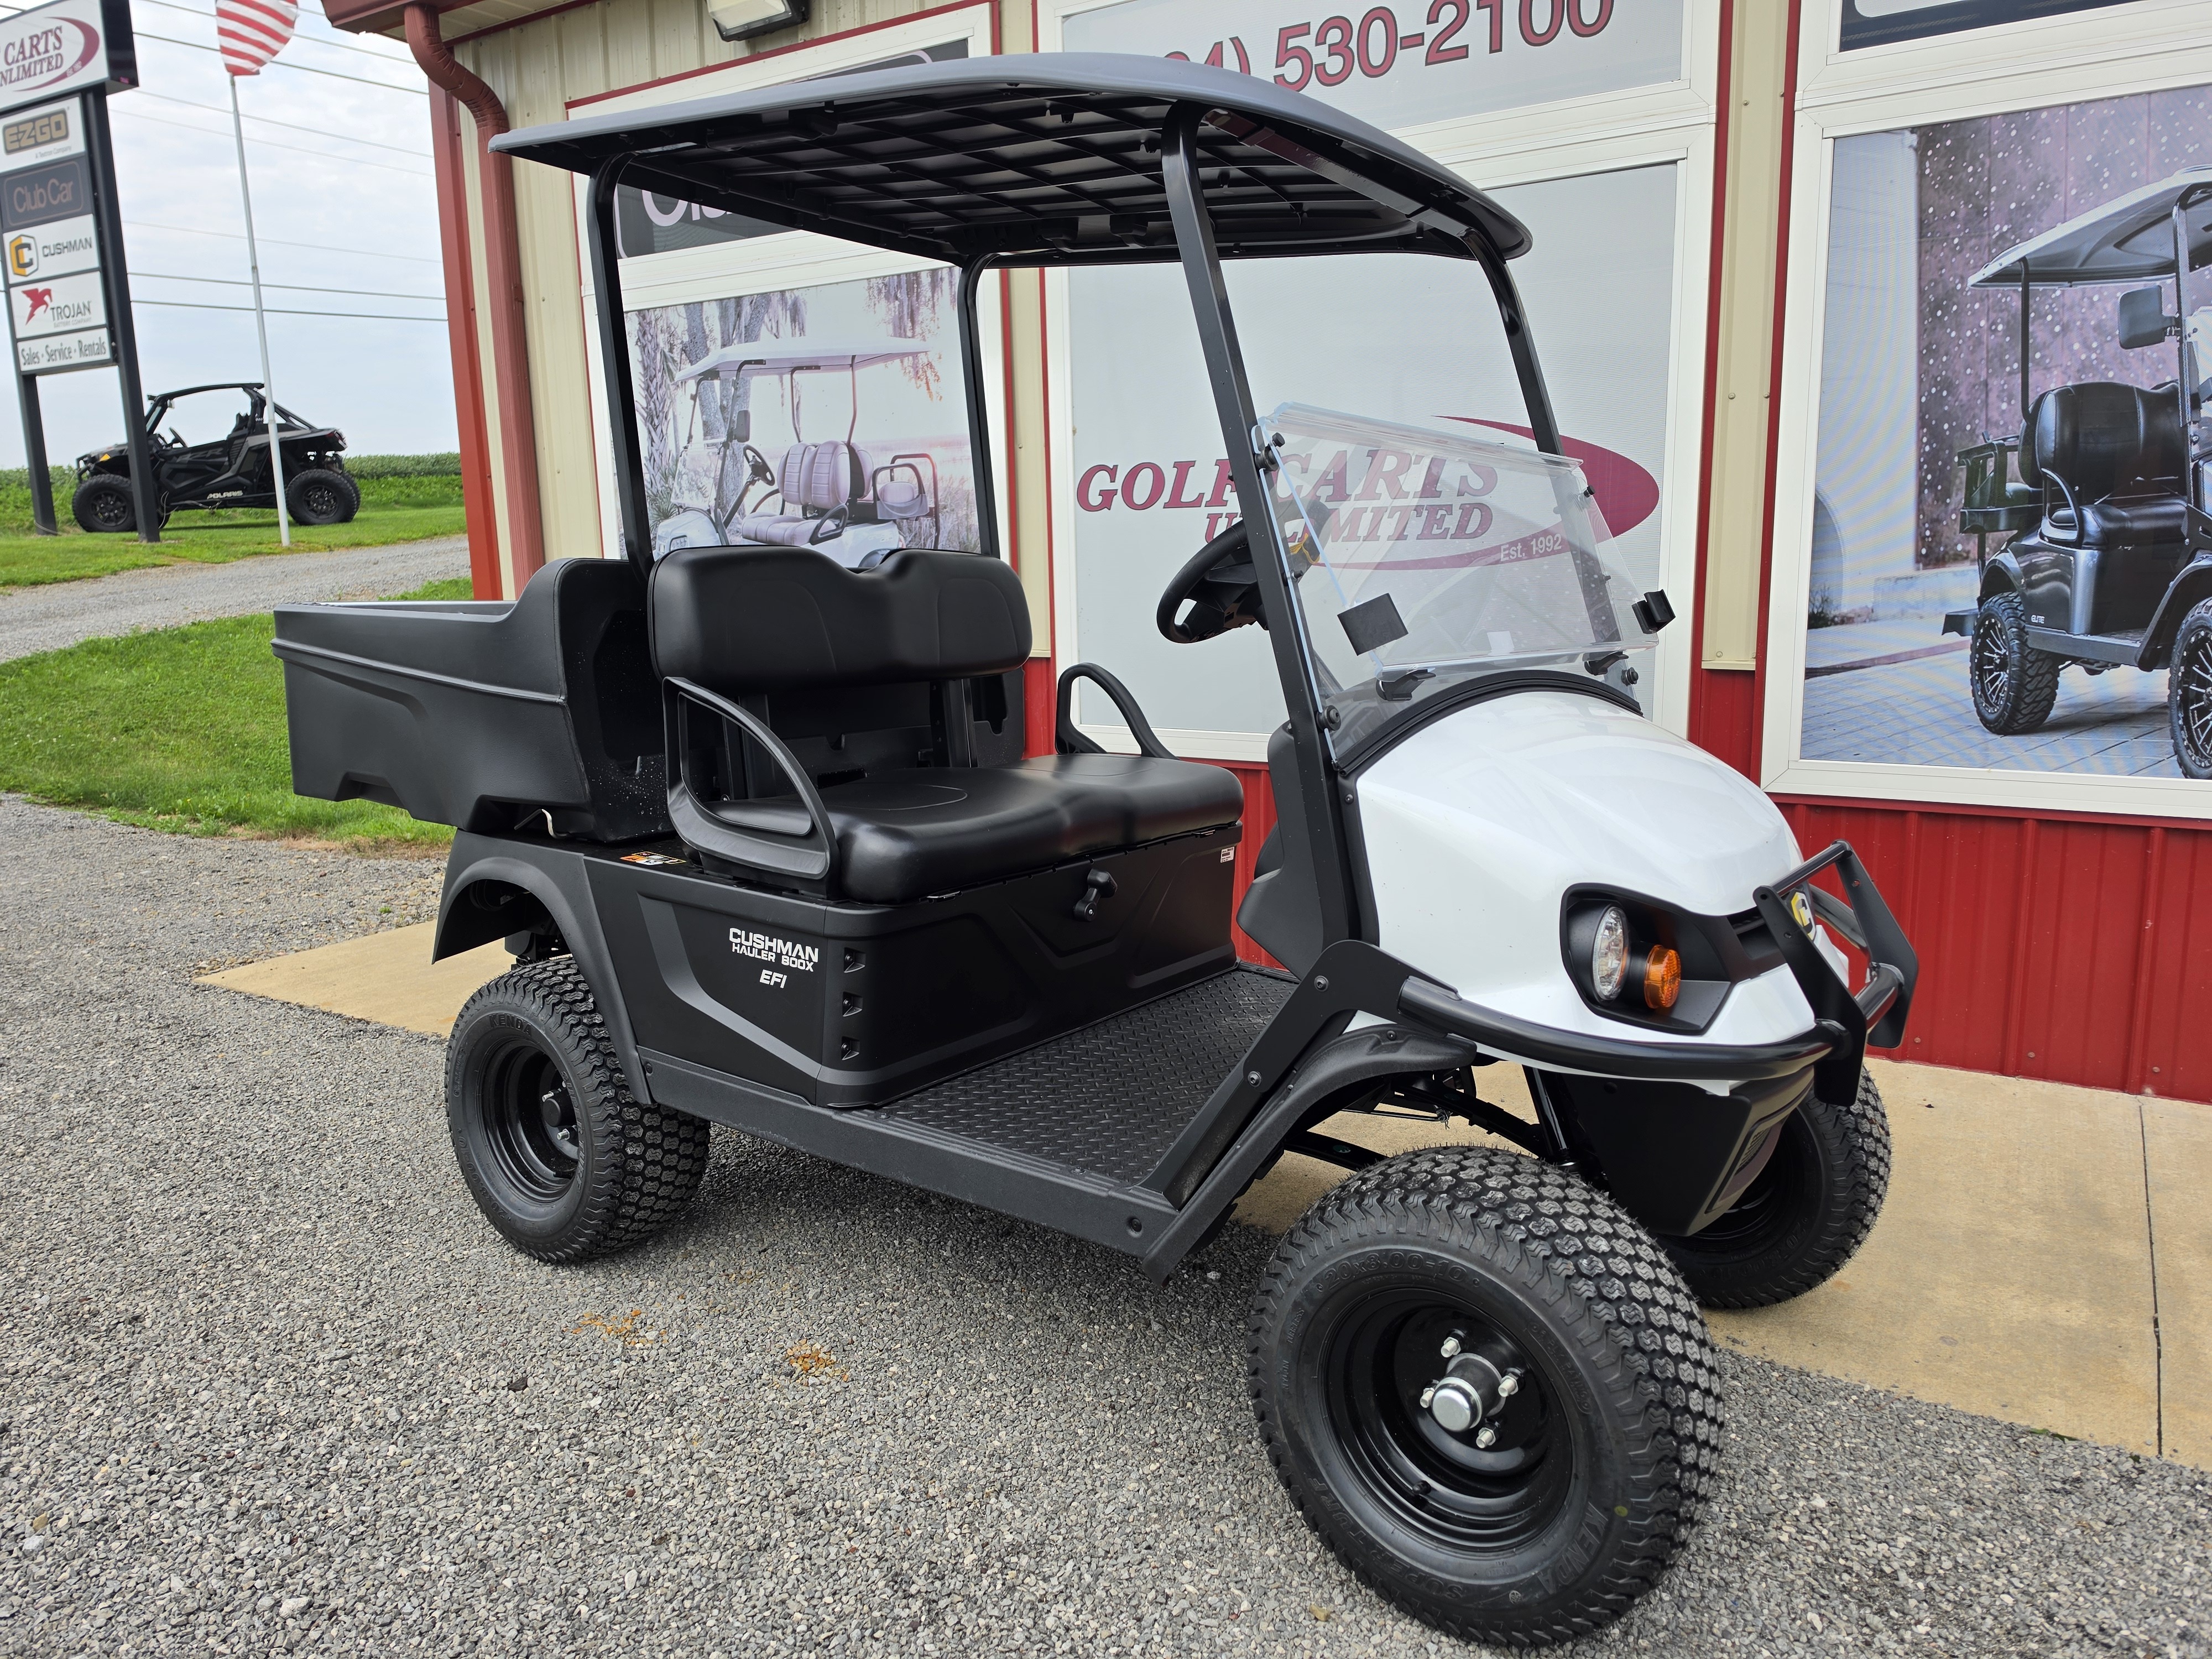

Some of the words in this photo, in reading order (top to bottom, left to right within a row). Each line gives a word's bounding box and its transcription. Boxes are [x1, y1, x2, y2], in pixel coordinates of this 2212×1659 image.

[4, 25, 62, 66] CARTS
[1274, 0, 1614, 93] 530-2100
[13, 183, 46, 213] Club
[48, 178, 73, 205] Car
[42, 237, 92, 257] CUSHMAN
[50, 302, 91, 322] TROJAN
[21, 348, 40, 366] Sales
[45, 342, 72, 363] Service
[77, 337, 107, 358] Rentals
[1271, 448, 1498, 503] CARTS
[207, 490, 243, 500] POLARIS
[1500, 542, 1525, 561] Est.
[1530, 534, 1562, 555] 1992
[729, 927, 819, 963] CUSHMAN
[732, 943, 776, 962] HAULER
[781, 955, 814, 972] 800X
[760, 969, 787, 988] EFI
[488, 1012, 532, 1037] KENDA
[1537, 1501, 1609, 1595] KENDA
